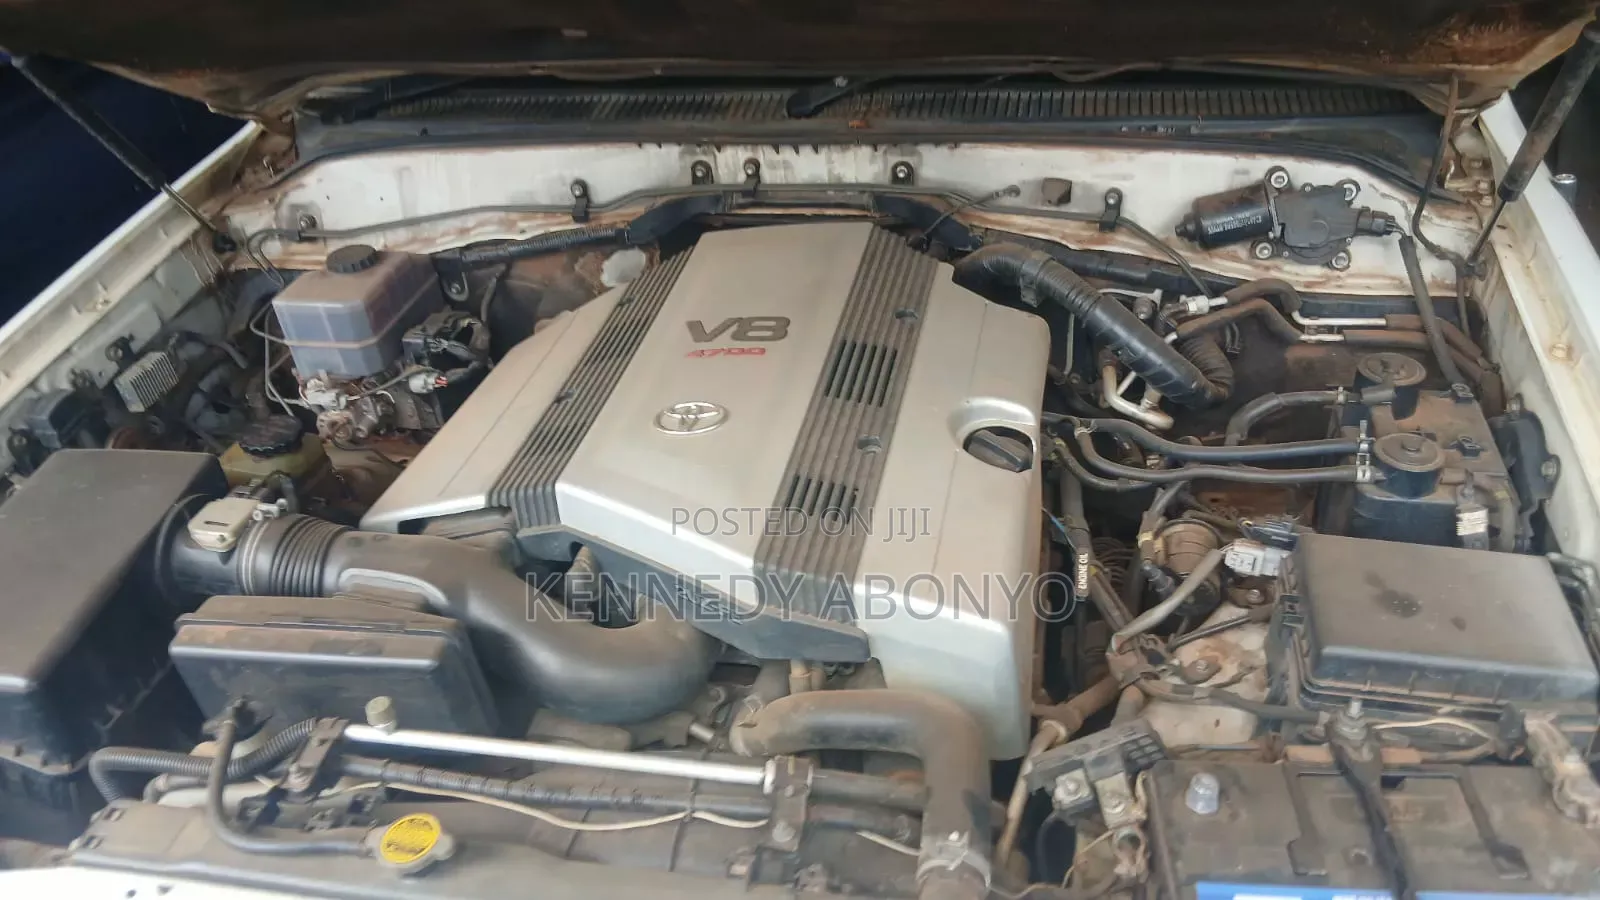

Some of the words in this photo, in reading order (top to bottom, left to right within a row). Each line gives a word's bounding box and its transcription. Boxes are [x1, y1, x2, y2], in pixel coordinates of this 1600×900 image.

[686, 316, 791, 343] V8
[1078, 553, 1089, 564] OIL
[1077, 565, 1088, 590] ENGINE
